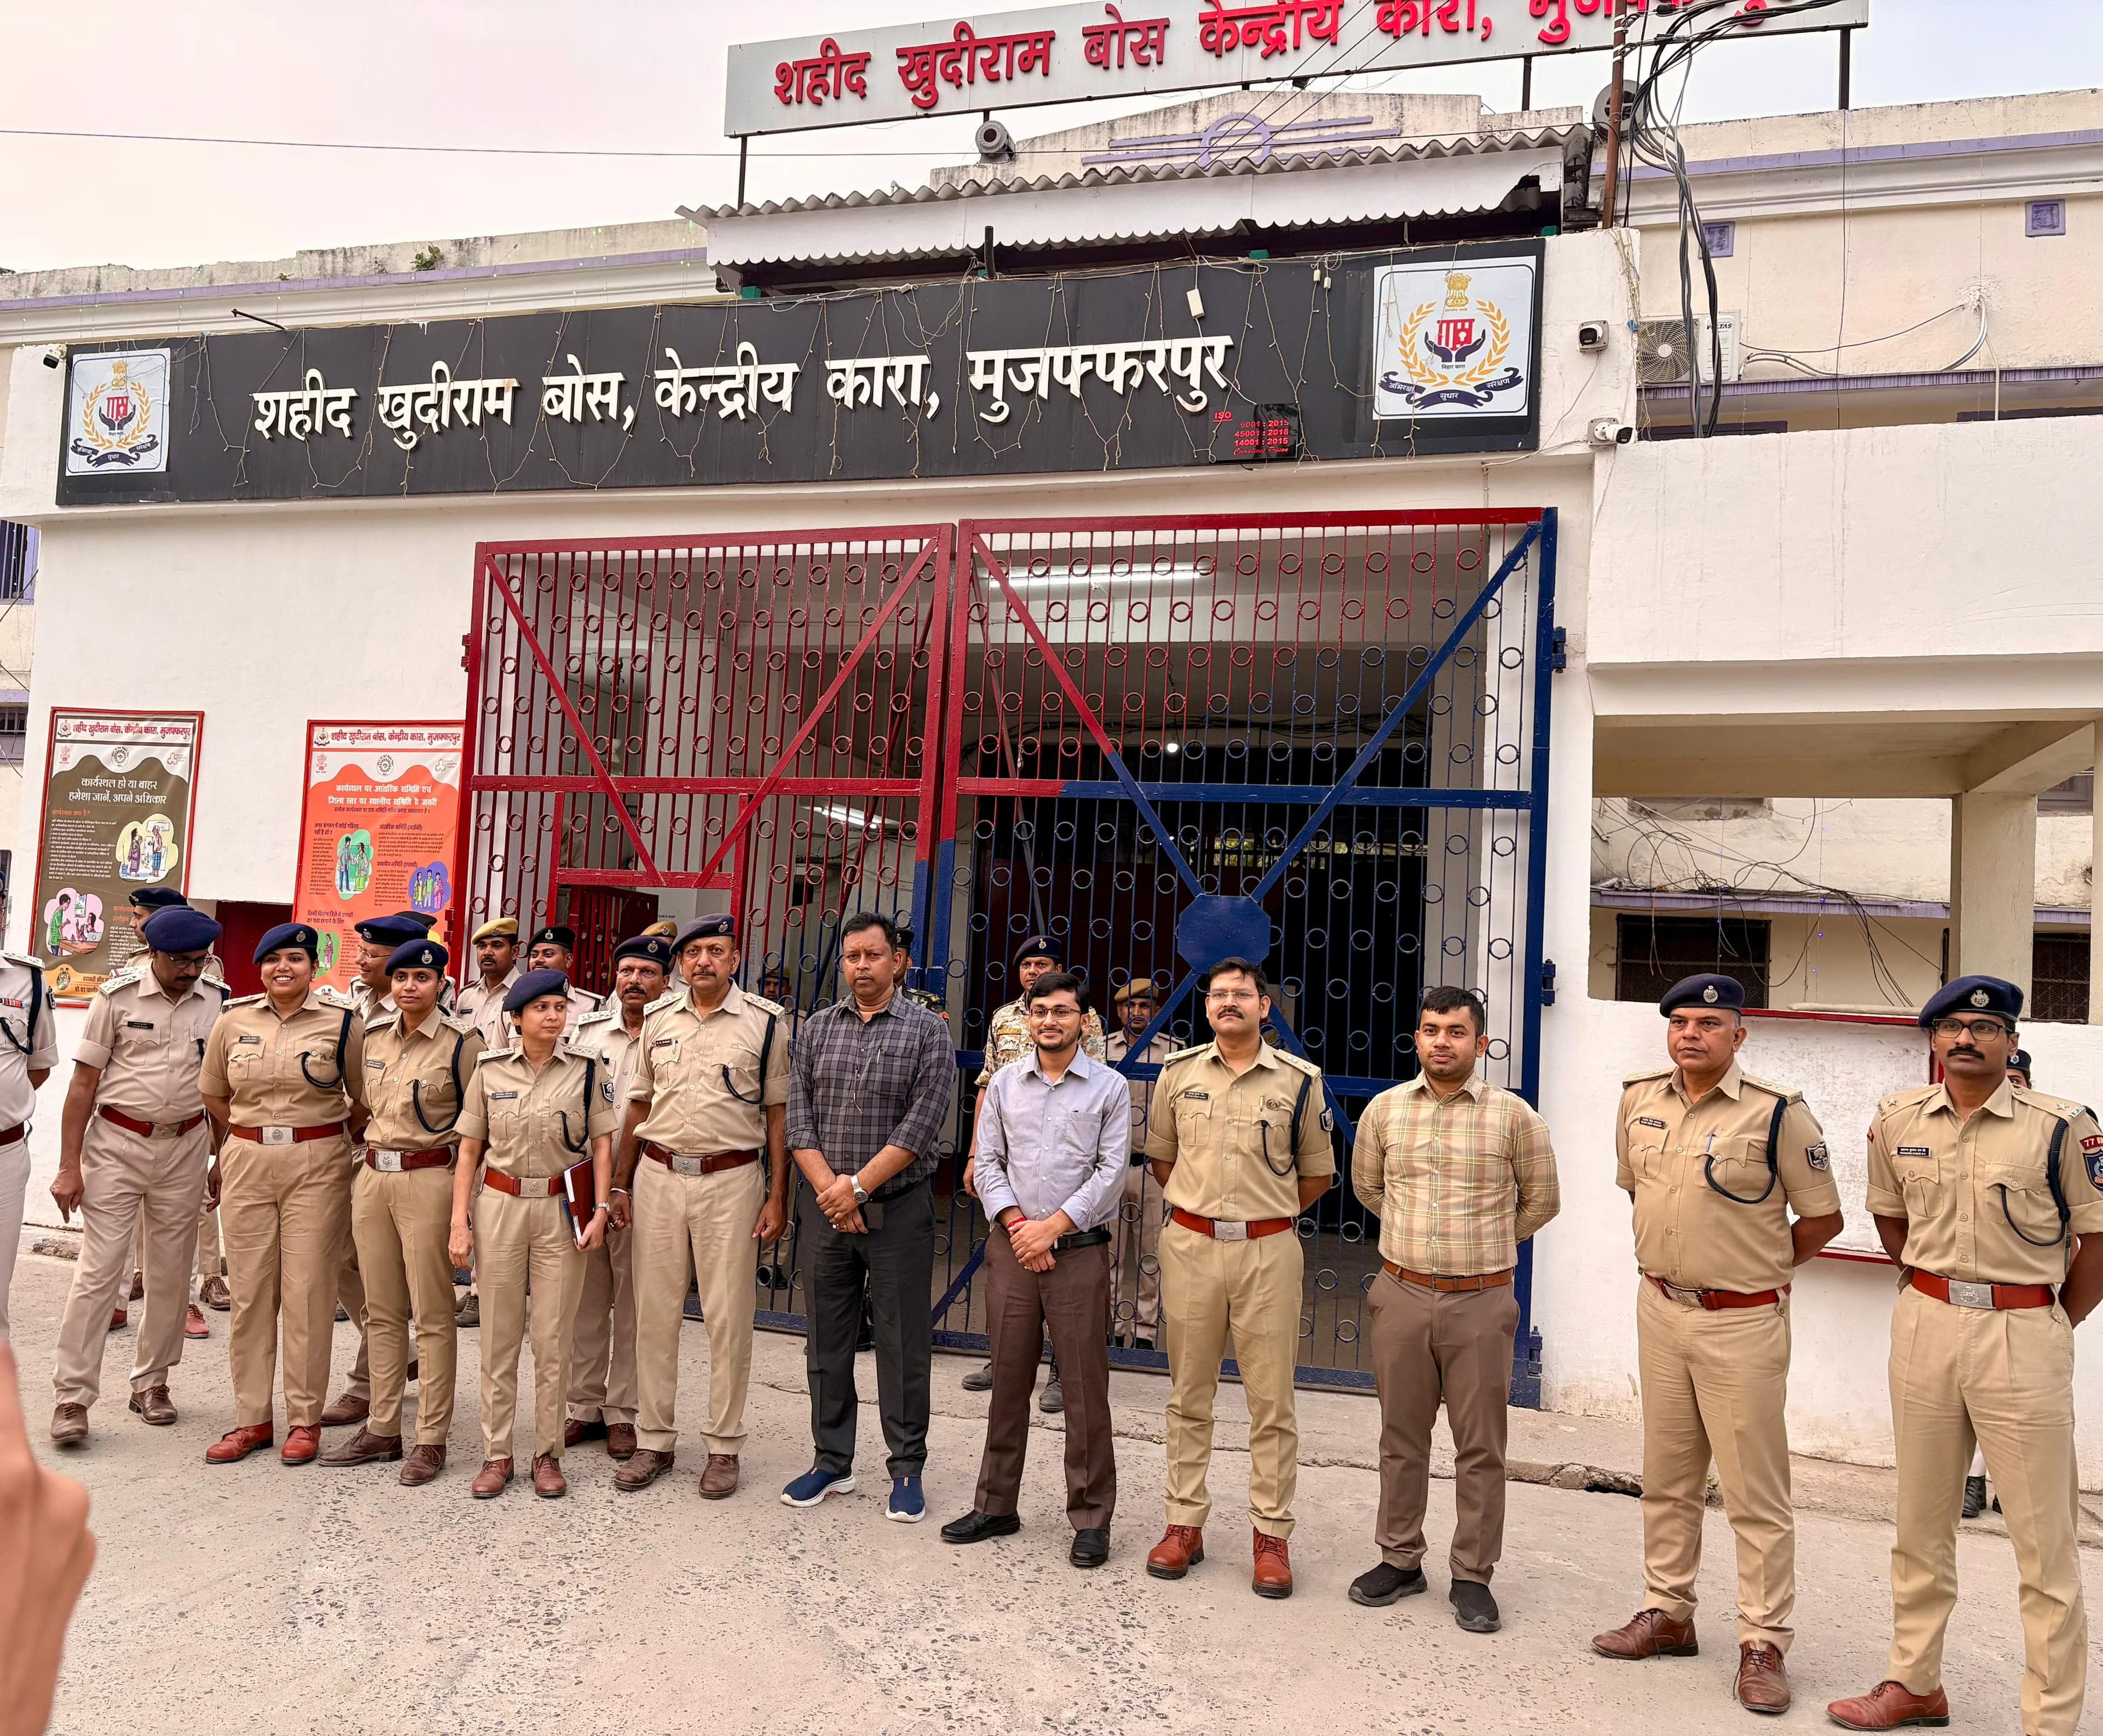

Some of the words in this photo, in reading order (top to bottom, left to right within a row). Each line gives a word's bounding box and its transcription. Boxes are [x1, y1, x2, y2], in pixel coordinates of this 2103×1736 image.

[774, 37, 871, 105] शहीद
[896, 21, 1055, 108] खुदीराम
[1083, 5, 1170, 69] बोस
[1198, 0, 1344, 58] केन्द्रीय
[251, 369, 359, 439] शहीद
[378, 361, 520, 450] खुदीराम
[542, 354, 634, 432] बोस,
[654, 341, 800, 420] केन्द्रीय
[825, 354, 941, 421] कारा,
[967, 335, 1233, 424] मुजफ्फरपुर
[1440, 392, 1459, 401] सुधार
[73, 721, 87, 733] शहीद
[89, 722, 108, 737] खुदीराम
[331, 729, 347, 741] शहीद
[349, 729, 371, 744] खुदीराम
[82, 775, 116, 787] कार्यस्थल
[118, 776, 125, 789] हो
[128, 780, 137, 789] या
[139, 780, 157, 790] बाहर
[401, 784, 420, 793] समिति
[69, 789, 90, 802] हमेशा
[113, 790, 133, 803] अपने
[135, 792, 166, 804] अधिकार
[2084, 1138, 2095, 1147] 77
